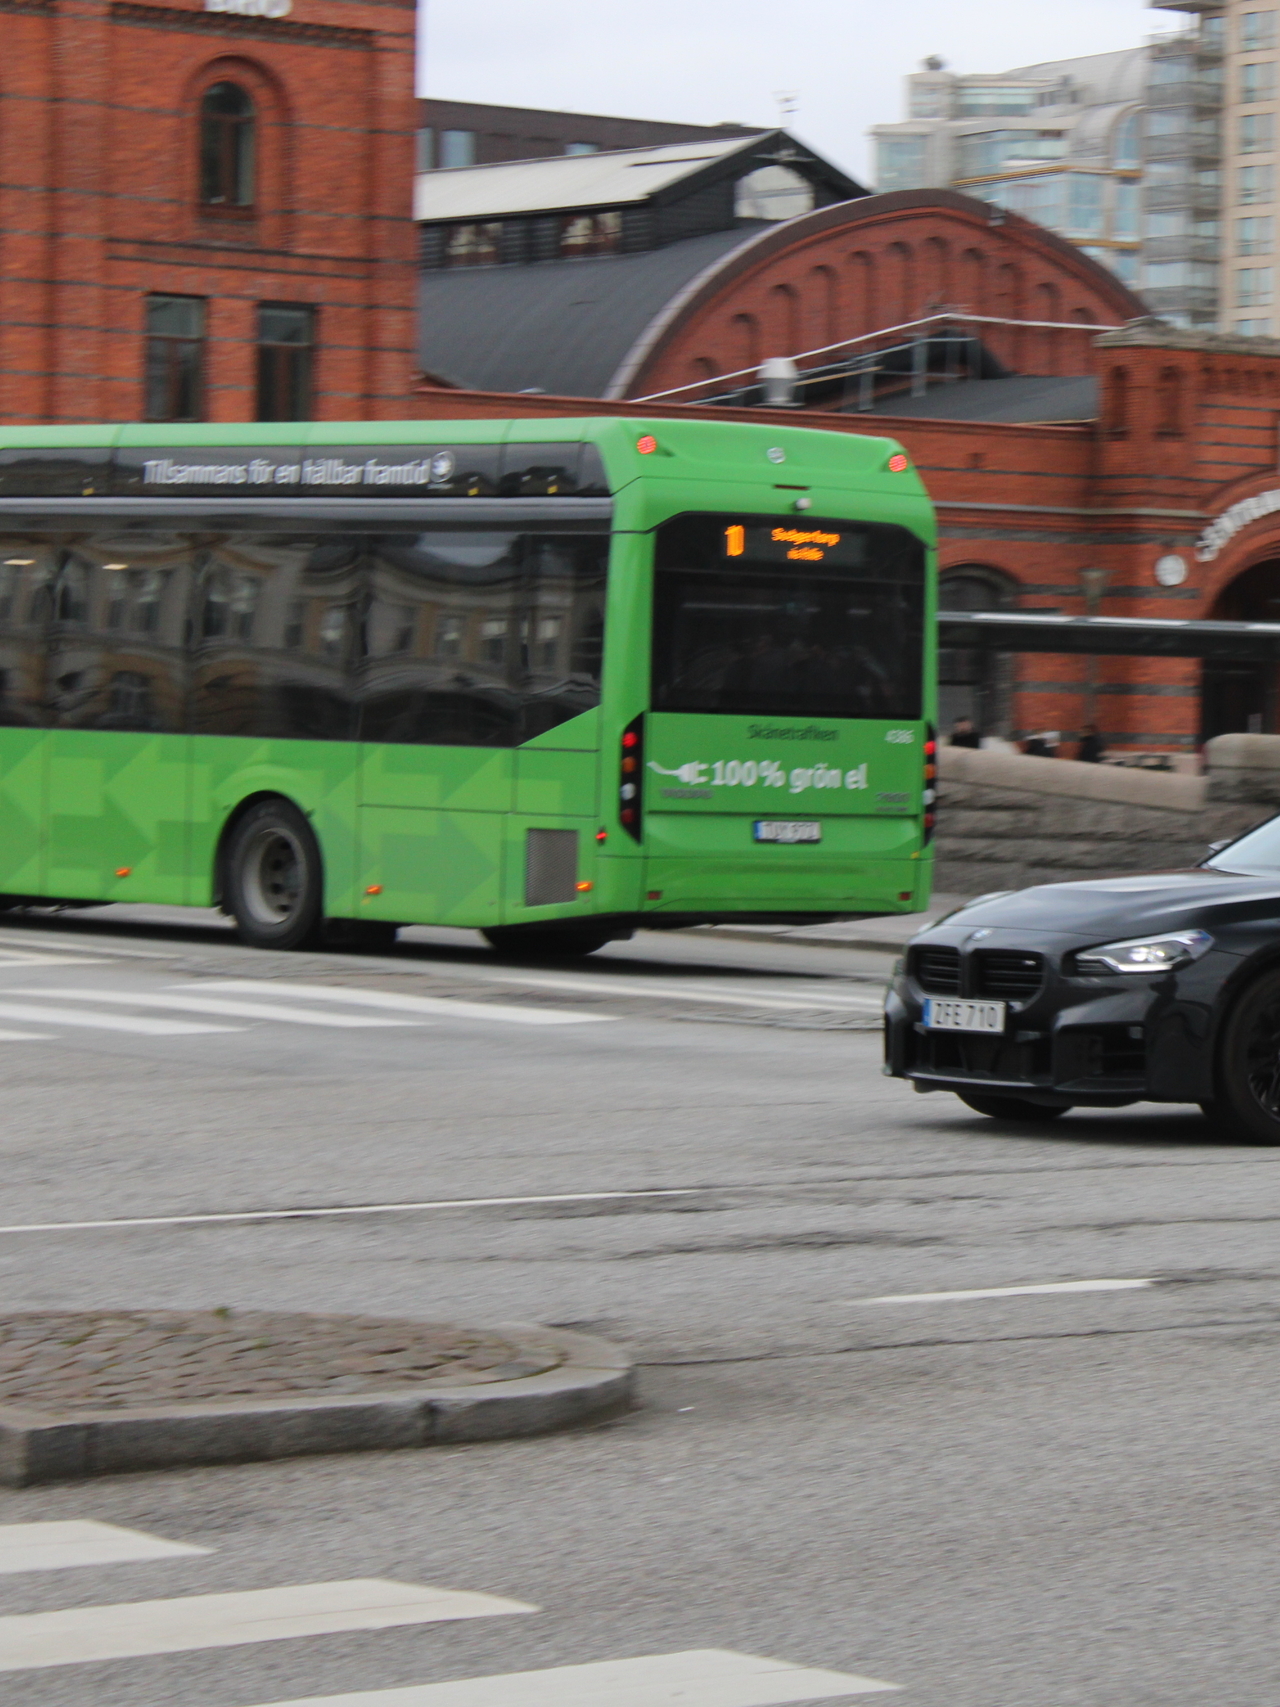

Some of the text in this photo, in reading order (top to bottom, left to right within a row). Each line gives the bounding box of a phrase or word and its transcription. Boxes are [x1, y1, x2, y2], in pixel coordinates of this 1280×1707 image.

[142, 459, 249, 484] Tillsammans
[248, 458, 277, 484] för
[275, 464, 301, 484] en
[363, 458, 432, 485] framtid
[724, 524, 745, 557] 1
[711, 759, 869, 794] 100% grön el
[934, 1002, 999, 1028] ZFE 710
